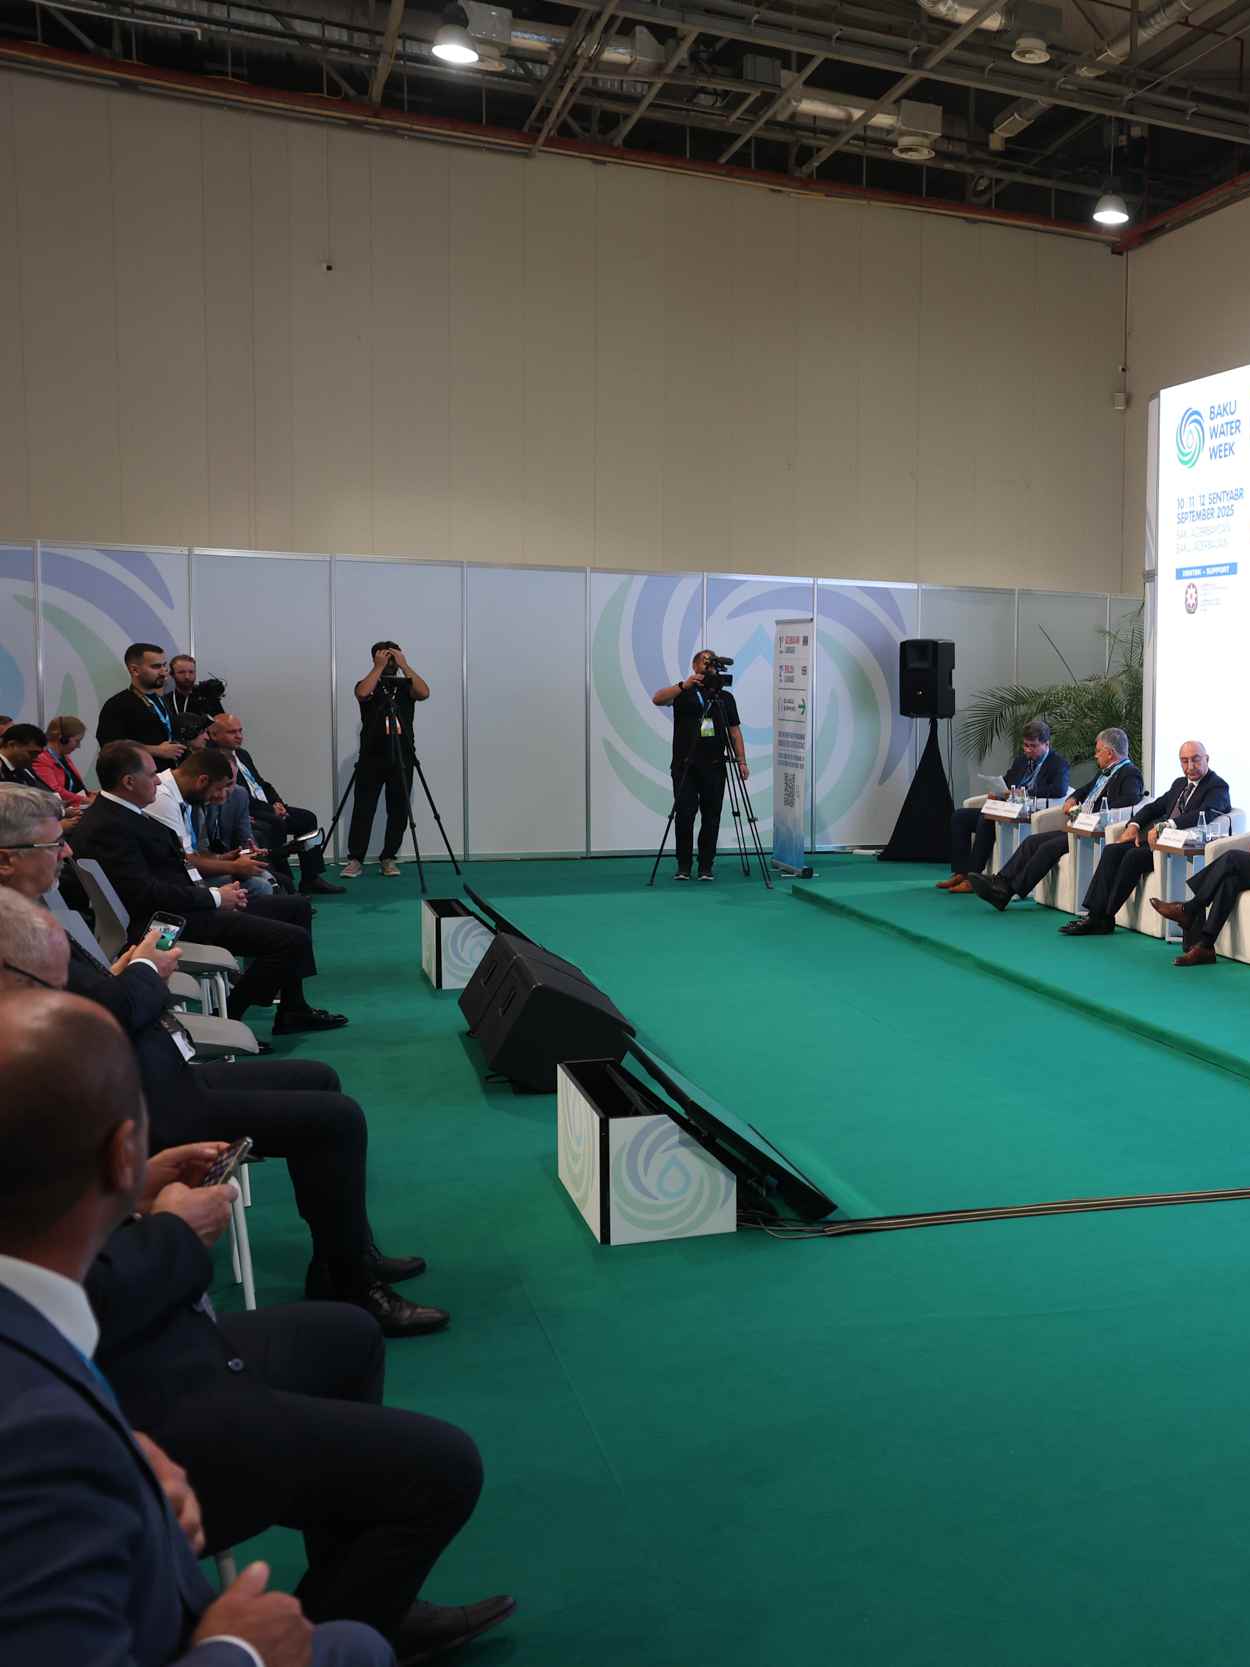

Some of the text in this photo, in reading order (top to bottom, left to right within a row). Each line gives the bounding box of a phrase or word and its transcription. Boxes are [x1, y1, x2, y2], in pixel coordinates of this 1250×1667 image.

[1208, 399, 1237, 421] BAKU
[1209, 419, 1241, 440] WATER
[1209, 442, 1235, 461] WEEK
[1177, 504, 1235, 525] SEPTEMBER 2025
